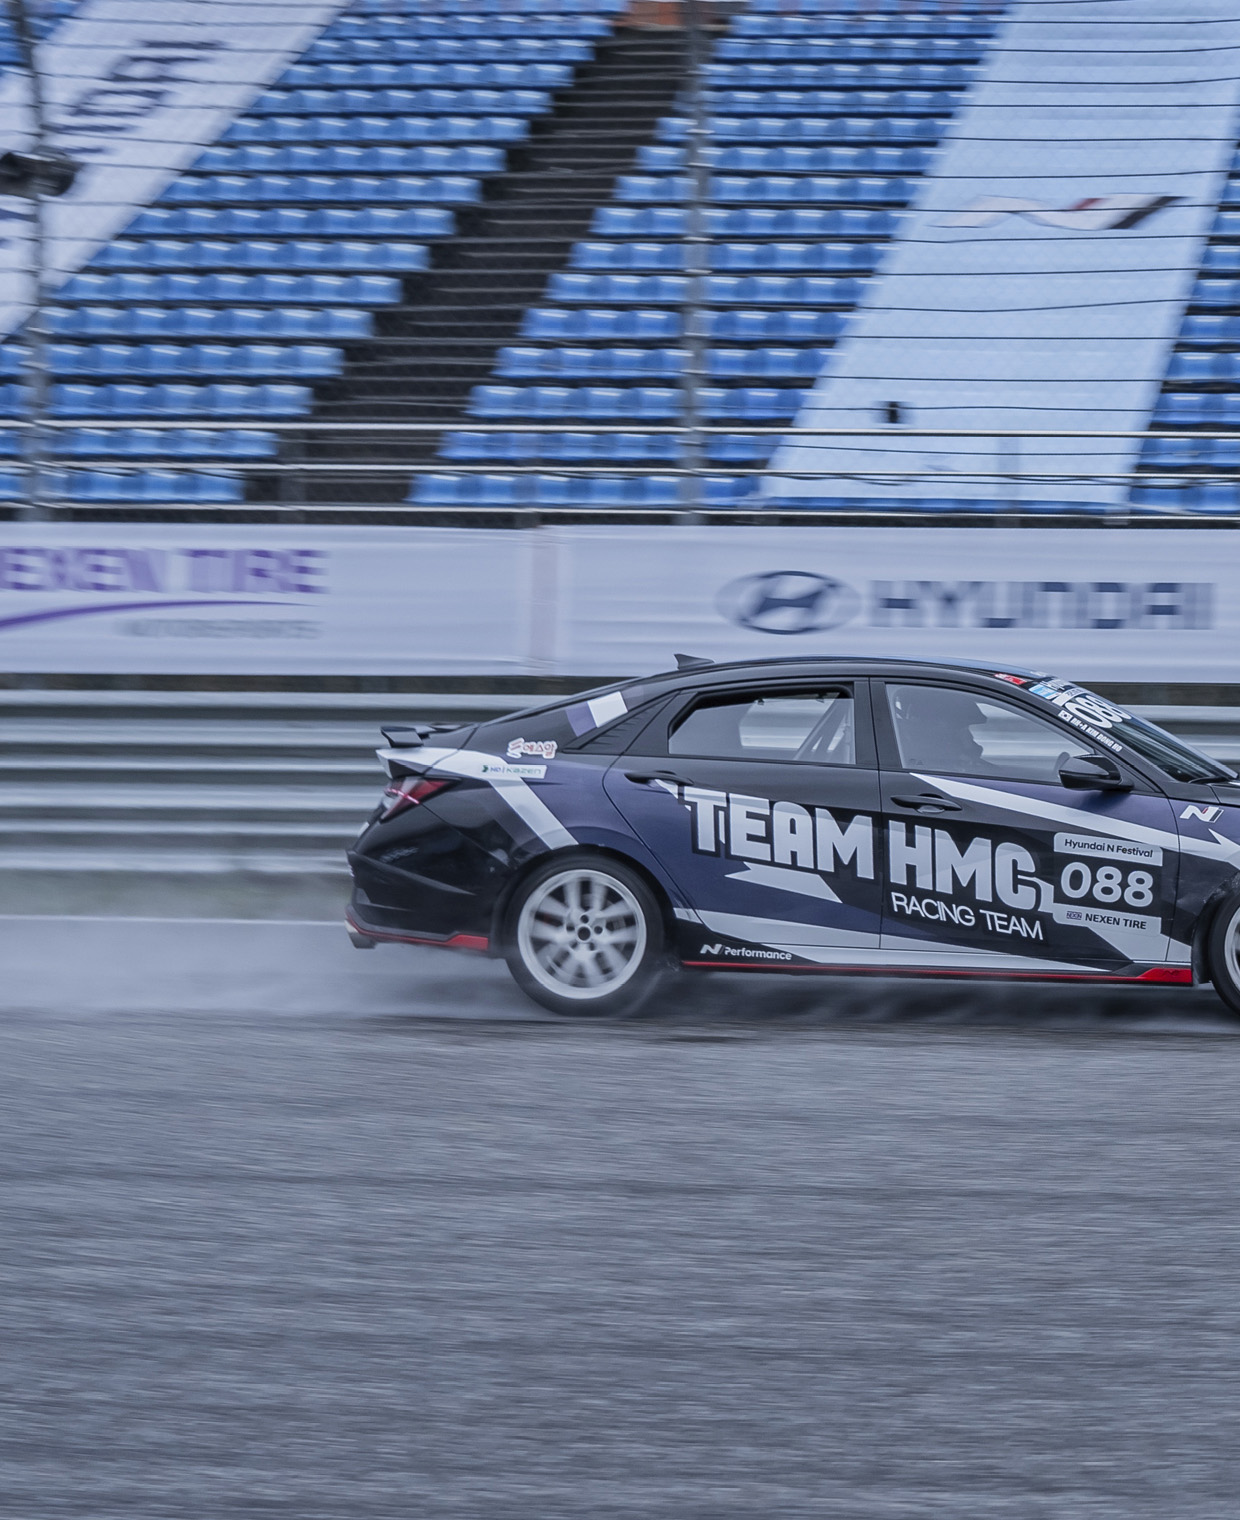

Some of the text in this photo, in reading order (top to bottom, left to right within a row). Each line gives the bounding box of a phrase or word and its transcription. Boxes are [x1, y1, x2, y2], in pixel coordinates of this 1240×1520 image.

[0, 547, 331, 594] EXEN TIRE
[868, 580, 1215, 629] HYUNDAI
[683, 786, 875, 880] TEAM
[1064, 839, 1153, 858] Hyundai N Festival
[1061, 862, 1154, 907] 088
[891, 891, 1044, 940] RACING TEAM
[1085, 913, 1120, 926] NEXEN
[1122, 918, 1147, 929] TIRE
[724, 946, 792, 960] Performance
